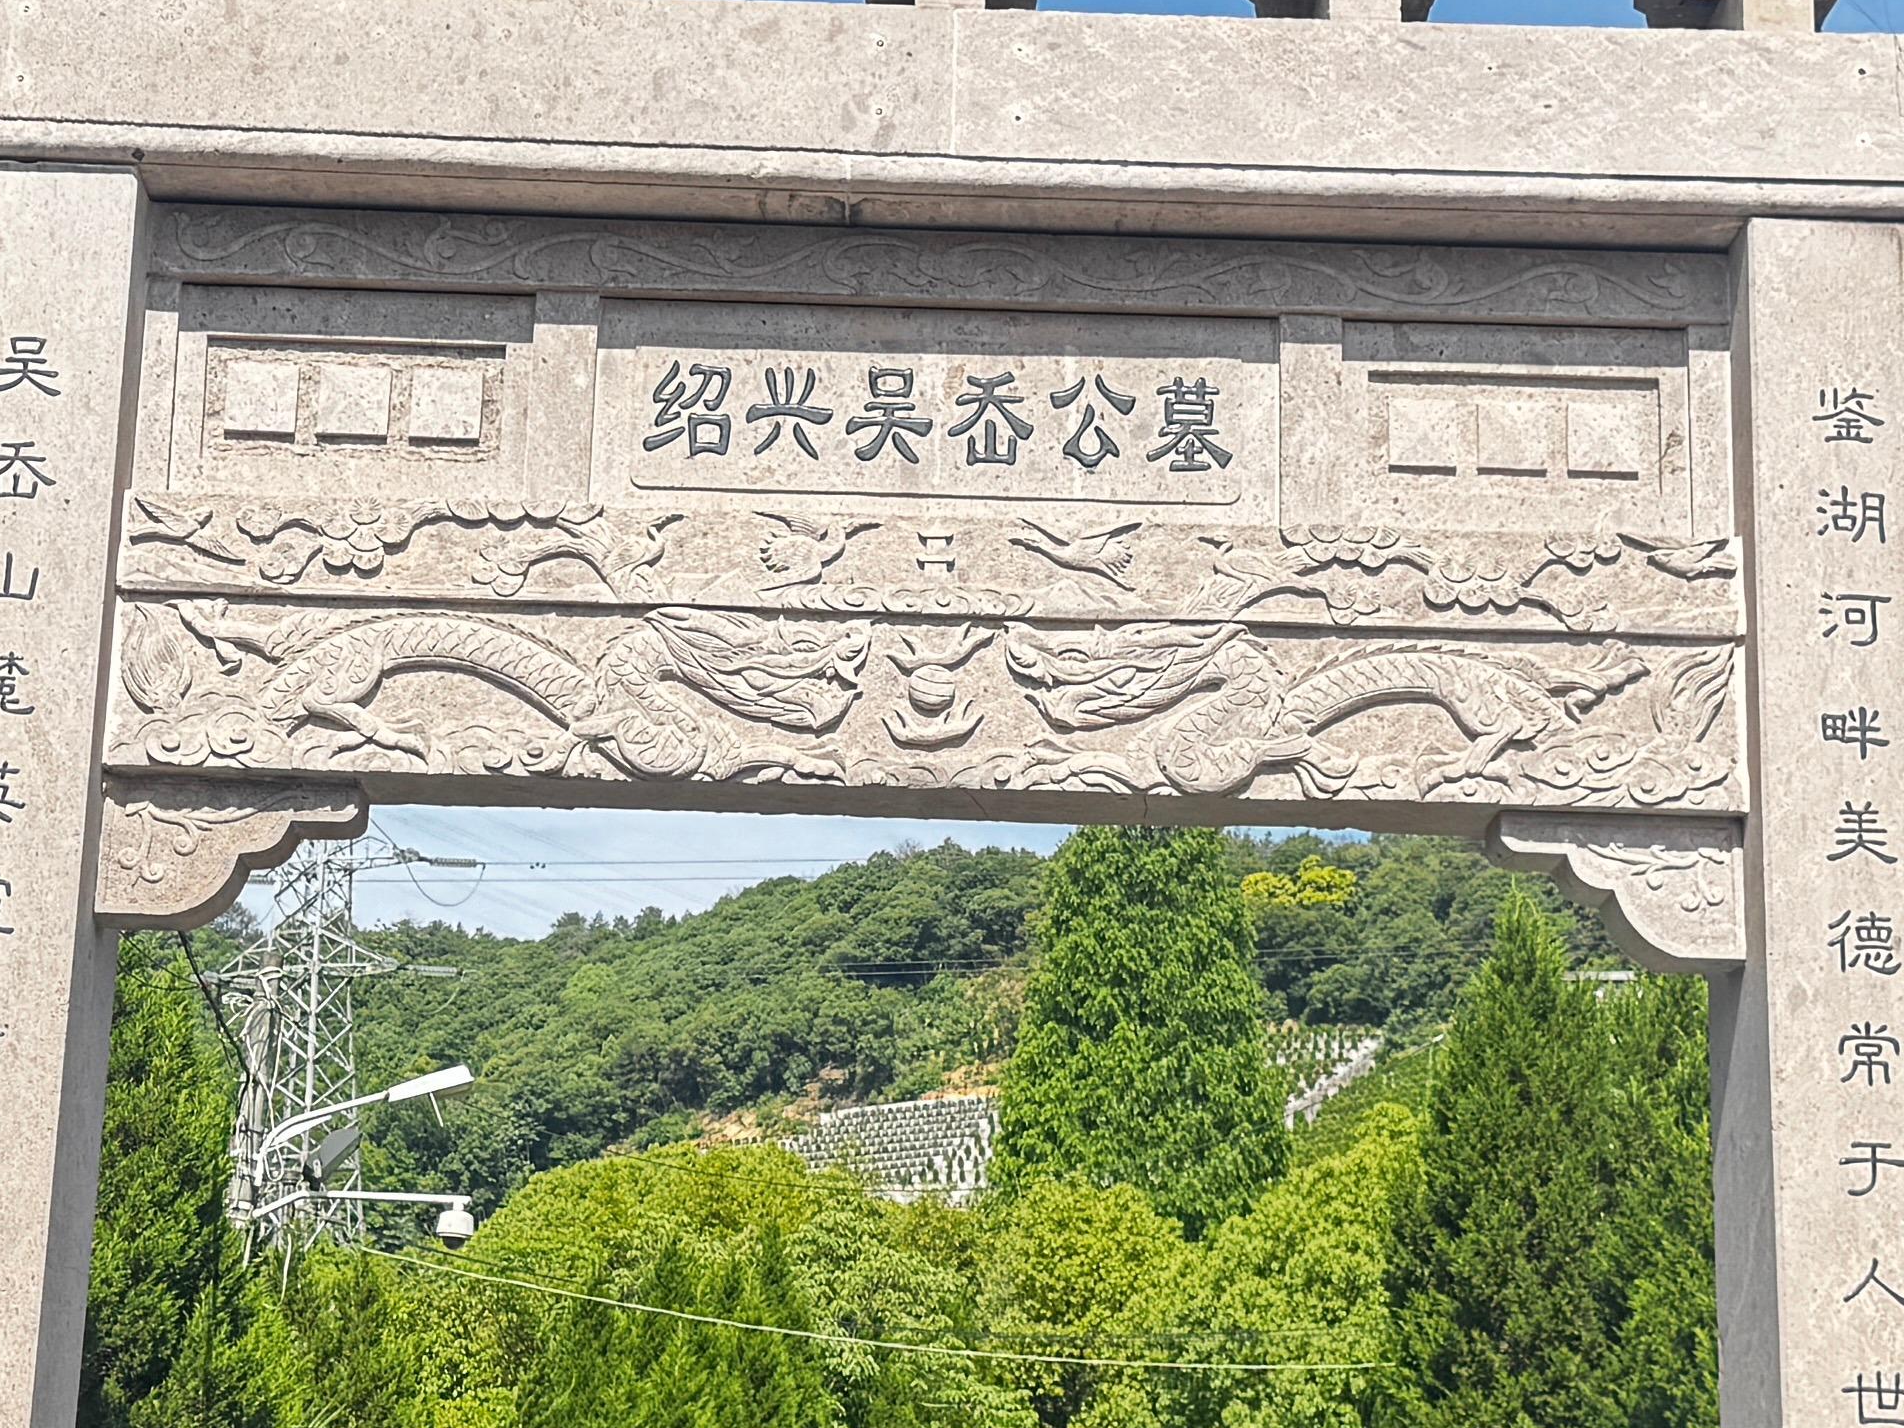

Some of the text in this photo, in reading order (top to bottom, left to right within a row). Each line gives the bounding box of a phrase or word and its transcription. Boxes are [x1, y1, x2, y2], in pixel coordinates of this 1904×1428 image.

[642, 359, 1233, 473] 绍兴吴岙公墓
